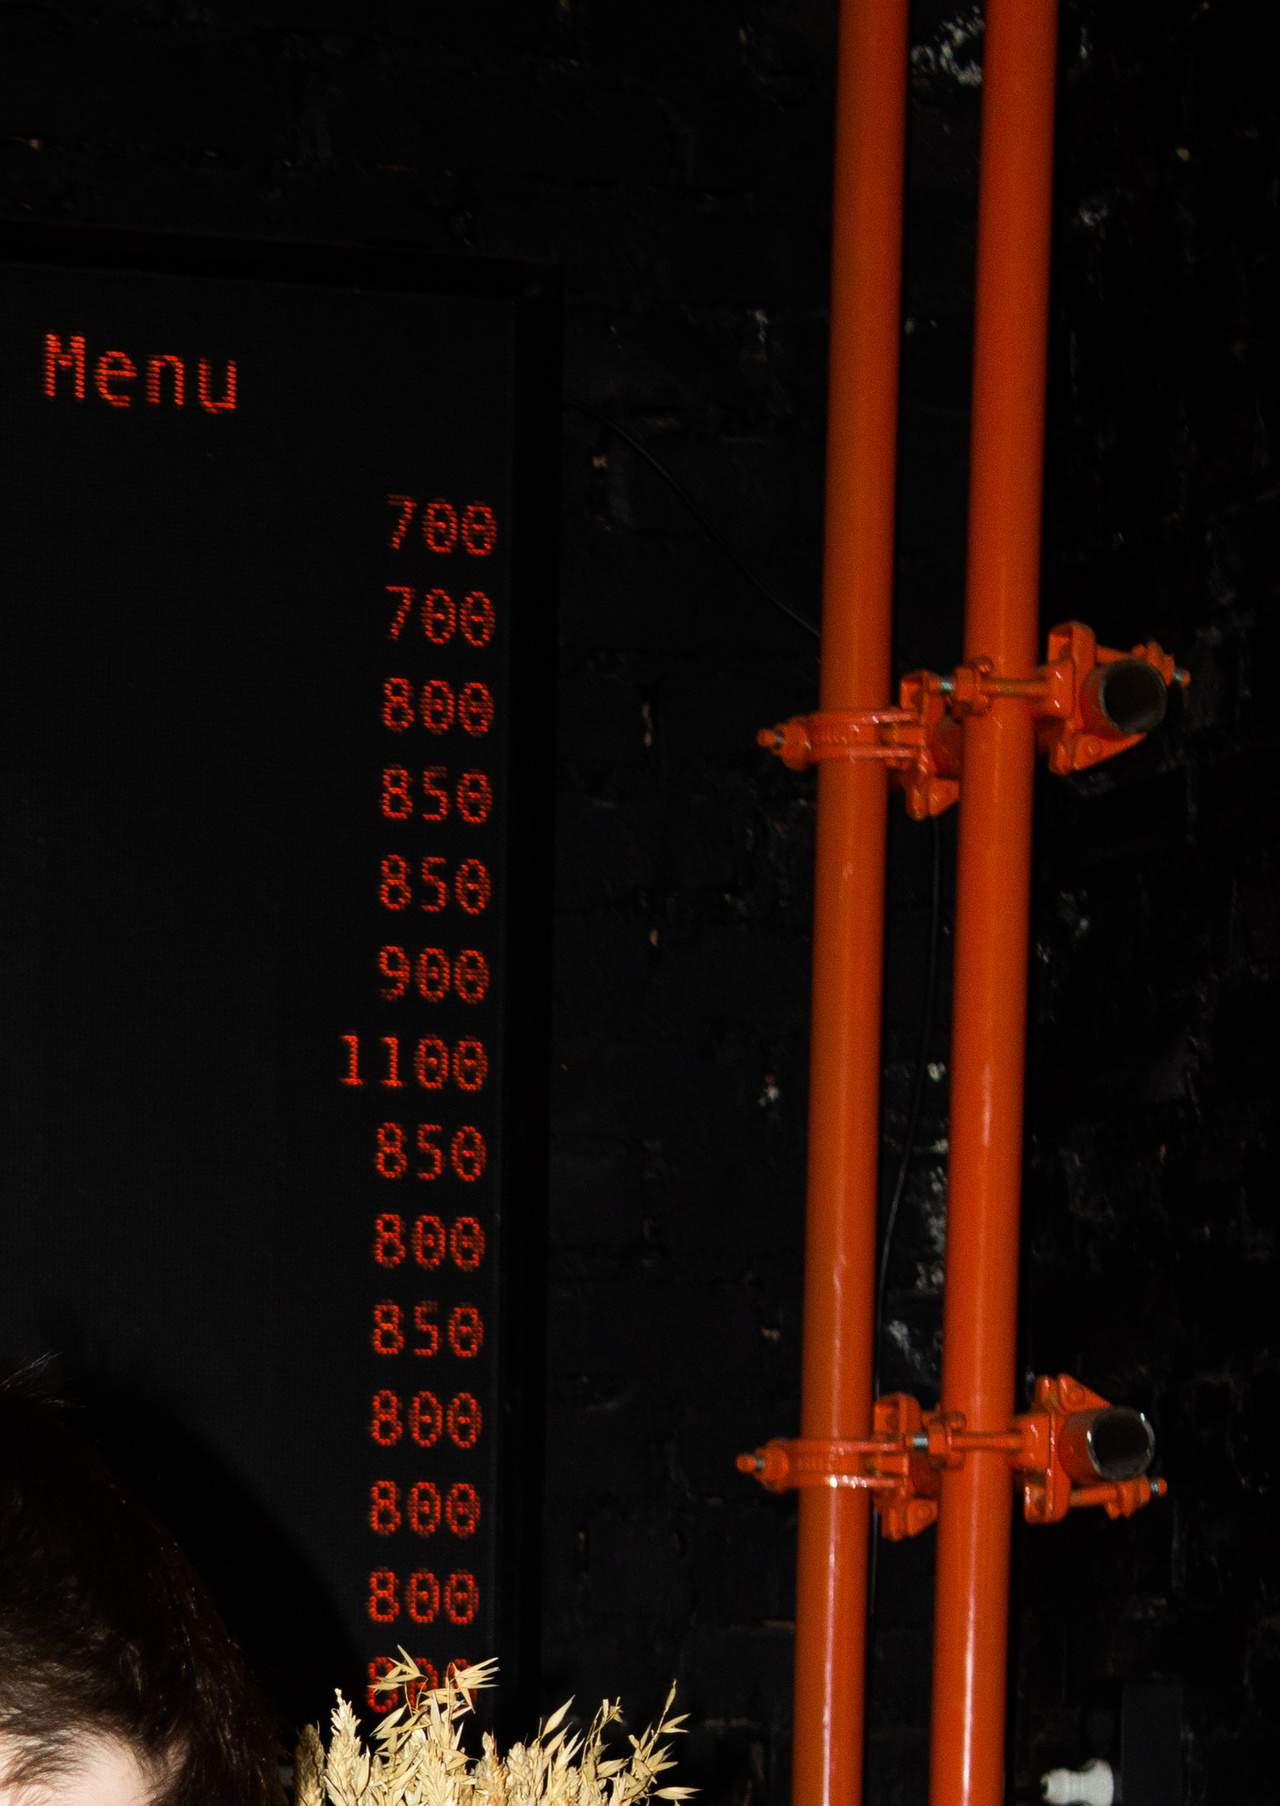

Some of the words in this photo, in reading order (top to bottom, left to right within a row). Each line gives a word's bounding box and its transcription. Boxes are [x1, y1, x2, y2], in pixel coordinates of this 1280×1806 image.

[44, 333, 238, 414] Menu
[385, 496, 498, 556] 700
[384, 585, 496, 648] 700
[382, 676, 495, 735] 800
[380, 766, 493, 824] 850
[379, 853, 491, 915] 850
[378, 944, 490, 1002] 900
[338, 1033, 489, 1092] 1100
[374, 1121, 487, 1183] 850
[373, 1212, 486, 1270] 800
[372, 1300, 484, 1359] 850
[370, 1389, 483, 1449] 800
[368, 1479, 482, 1538] 800
[368, 1568, 480, 1626] 800
